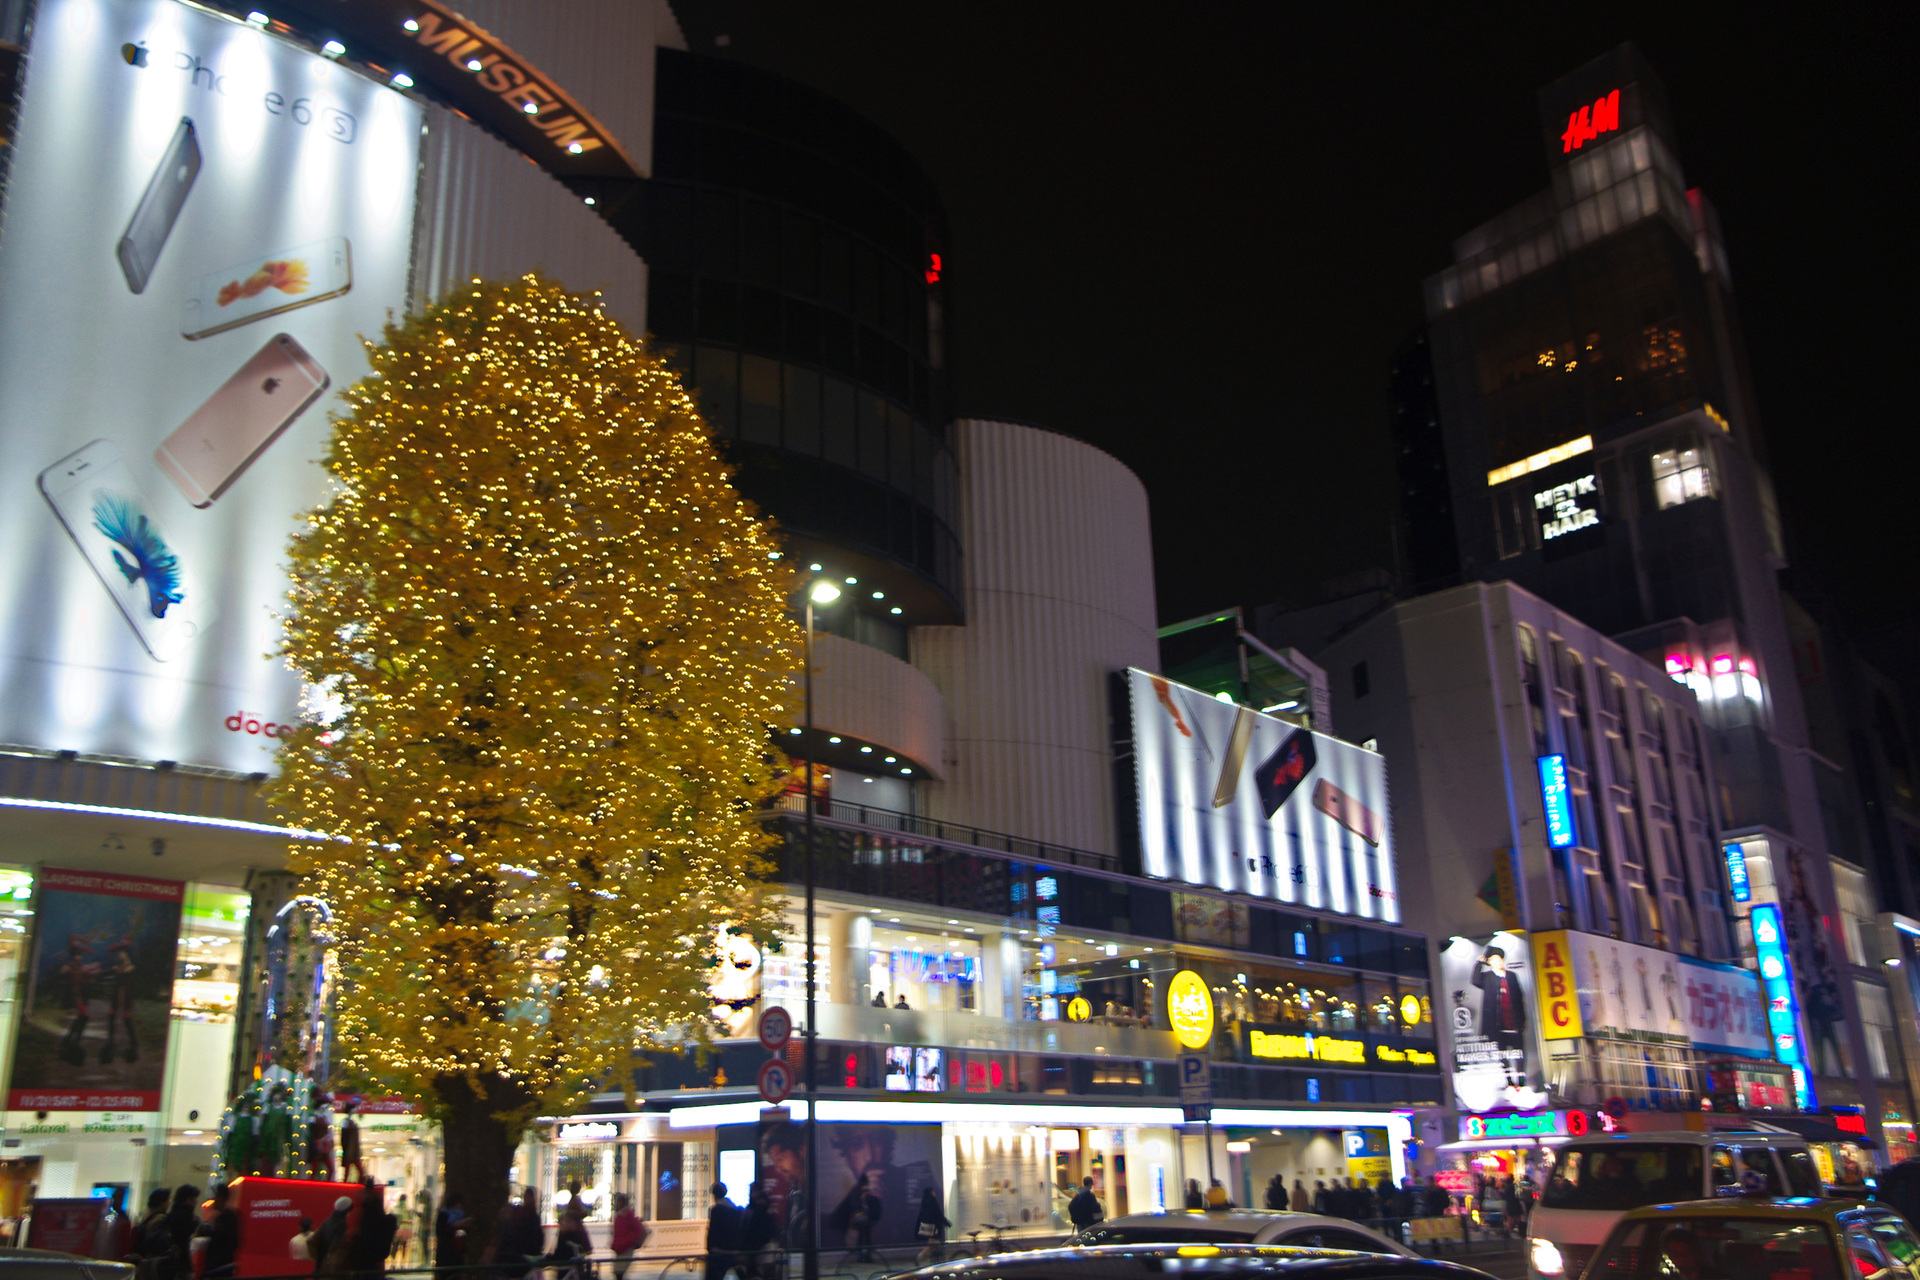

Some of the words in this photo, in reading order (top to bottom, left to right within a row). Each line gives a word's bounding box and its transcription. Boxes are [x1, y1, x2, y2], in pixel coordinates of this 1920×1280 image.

[403, 12, 604, 156] MUSEUM
[1542, 508, 1600, 540] HAIR
[1542, 942, 1570, 1027] ABC
[765, 1018, 784, 1038] 50
[1184, 1057, 1202, 1084] P
[1347, 1135, 1365, 1156] P
